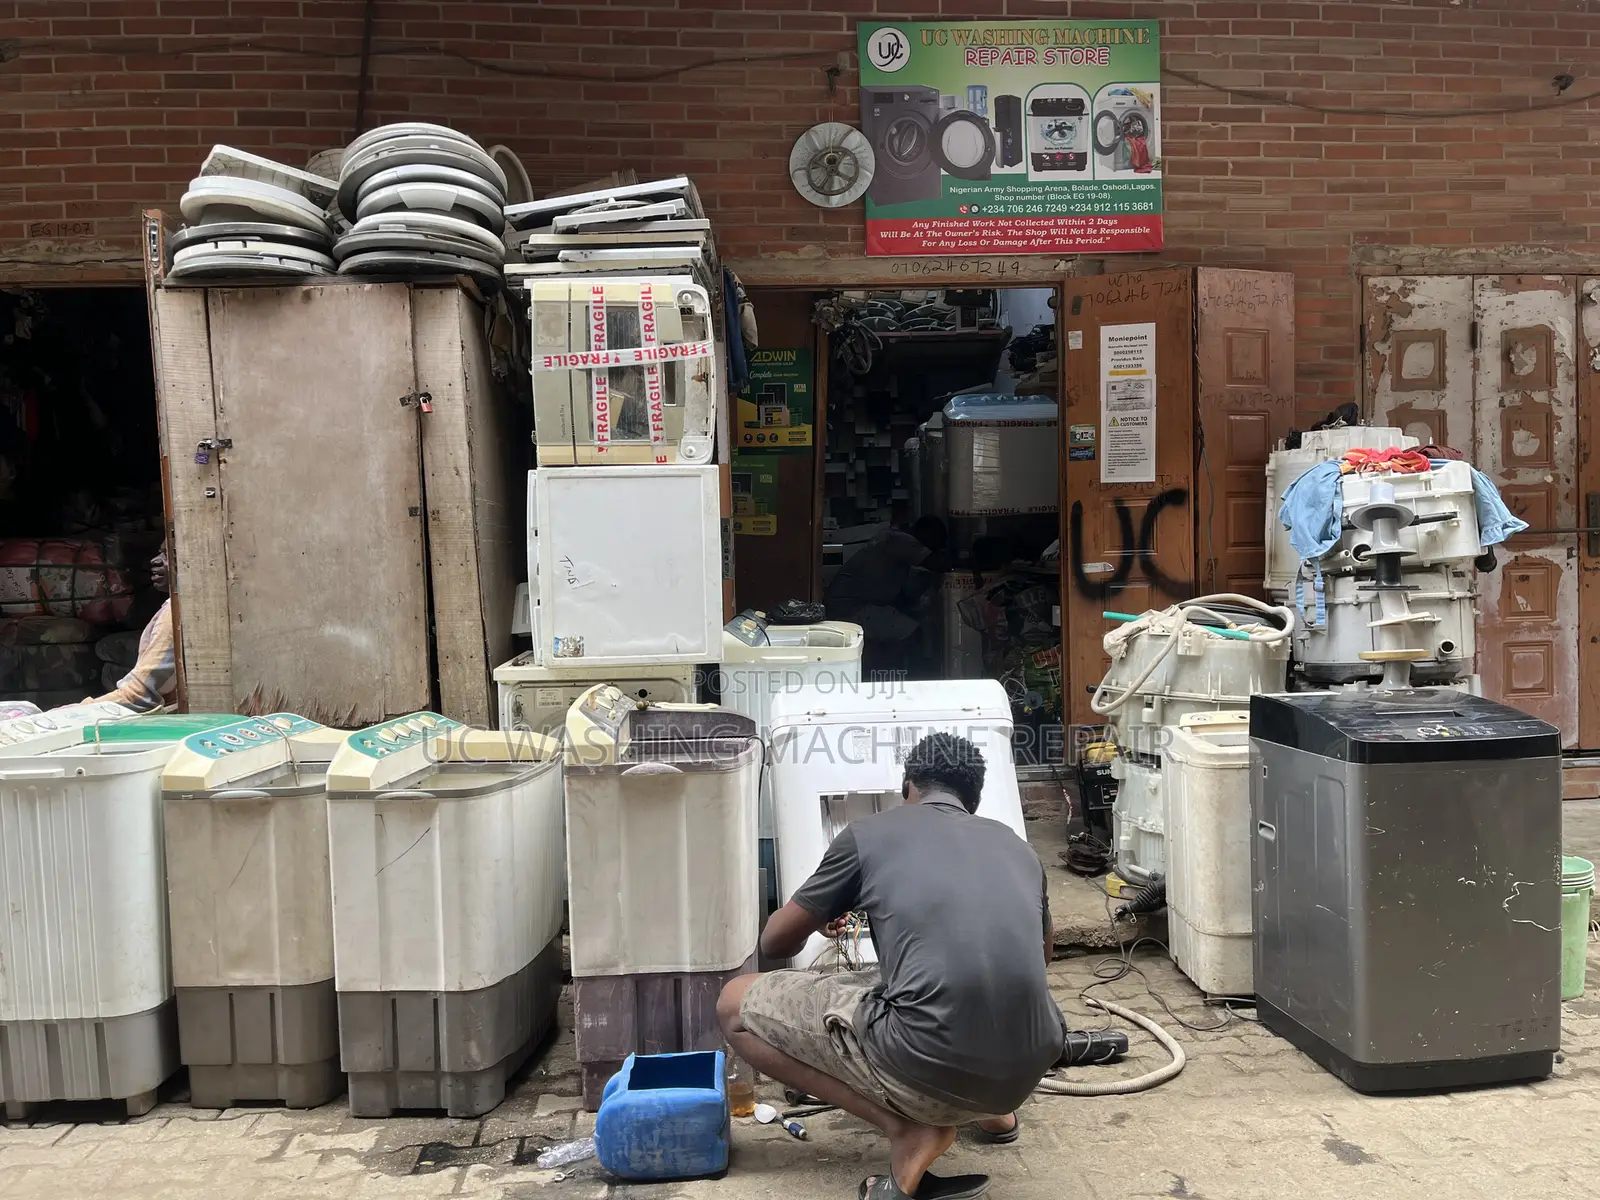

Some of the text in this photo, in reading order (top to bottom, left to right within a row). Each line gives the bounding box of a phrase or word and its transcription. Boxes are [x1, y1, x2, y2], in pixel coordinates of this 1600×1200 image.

[919, 27, 1151, 46] UC WASHING MACHINE
[964, 46, 1110, 67] REPAIR STORE
[949, 186, 983, 195] Nigerian
[984, 186, 1005, 194] Army
[1006, 184, 1043, 194] Shopping
[1016, 193, 1045, 201] number
[1047, 192, 1072, 201] (Block
[982, 202, 1154, 214] +234 706 246 7249 +234 912 115 3681
[31, 222, 91, 238] EG 19-07
[1014, 219, 1055, 227] Collected
[1097, 218, 1118, 226] Days
[1025, 228, 1048, 237] Shop
[1099, 226, 1151, 236] Responsible
[938, 240, 956, 248] Any
[993, 238, 1028, 248] Damage
[1029, 238, 1052, 247] After
[592, 286, 606, 351] FRAGILE
[640, 282, 655, 342] FRAGIL
[634, 344, 698, 361] FRAGILE
[750, 350, 797, 362] ADWIN
[543, 353, 610, 368] FRAGILE
[750, 371, 772, 380] Complete
[647, 366, 664, 436] FRAGILE
[595, 376, 609, 444] FRAGILE
[1070, 487, 1196, 603] UC
